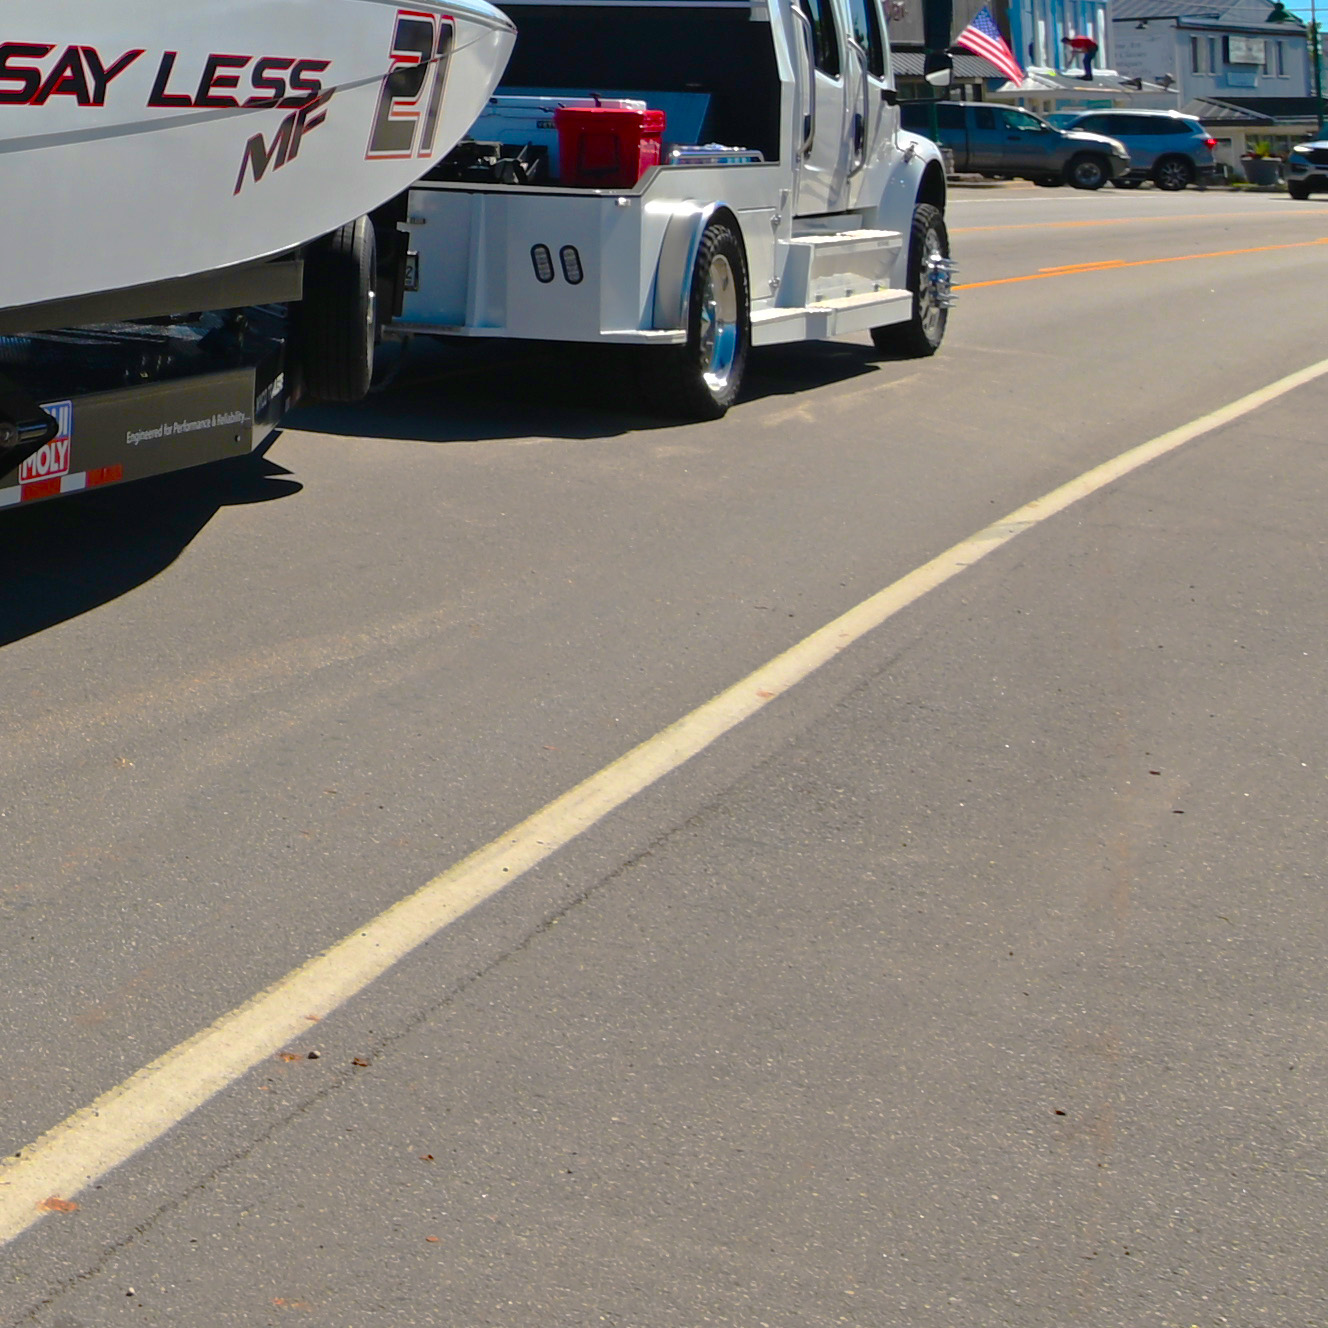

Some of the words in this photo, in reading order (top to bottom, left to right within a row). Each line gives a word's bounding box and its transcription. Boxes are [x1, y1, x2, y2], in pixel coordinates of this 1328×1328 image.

[146, 51, 332, 109] LESS
[364, 9, 455, 161] 21
[233, 87, 337, 196] MF
[22, 440, 68, 478] MOLY
[126, 424, 163, 446] Engineered
[163, 423, 173, 436] for
[173, 419, 211, 434] Performance
